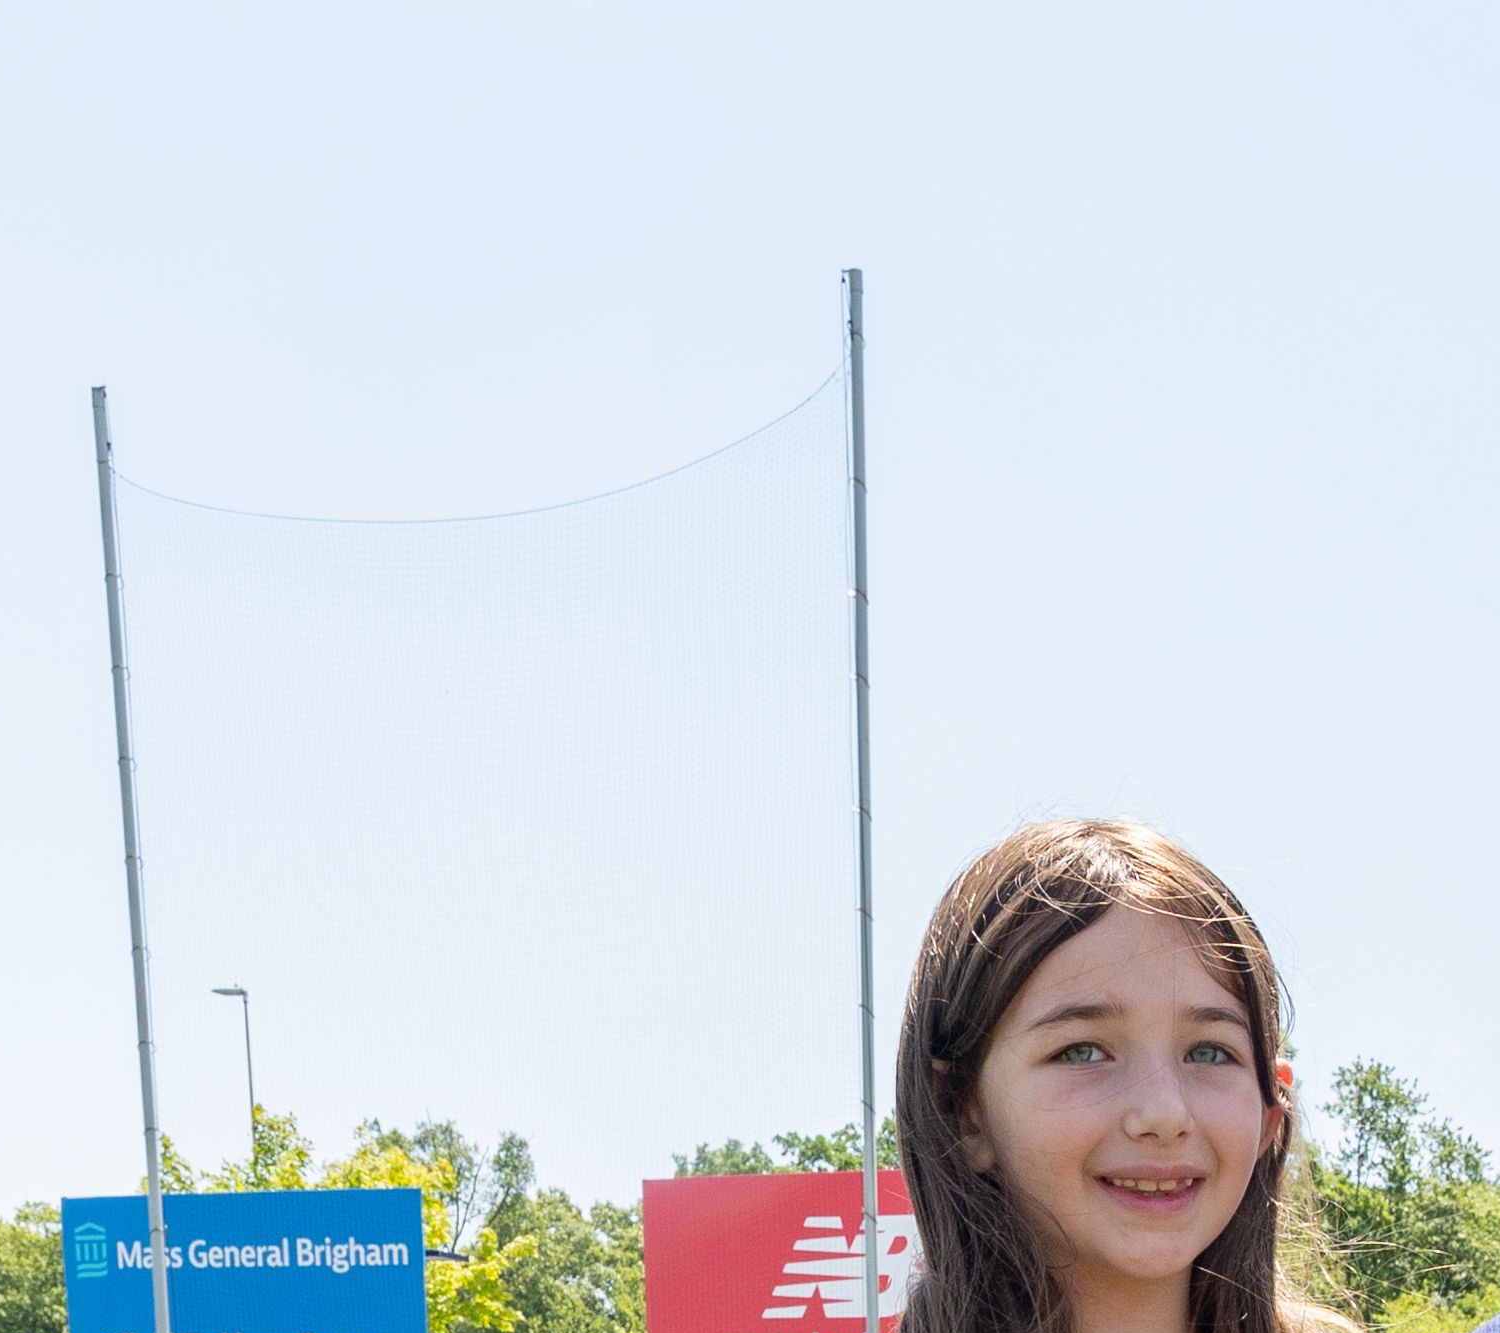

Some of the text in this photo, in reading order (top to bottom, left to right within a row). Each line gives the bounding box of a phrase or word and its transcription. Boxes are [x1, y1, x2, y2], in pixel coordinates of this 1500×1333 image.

[116, 1236, 409, 1273] Mas General Brigham
